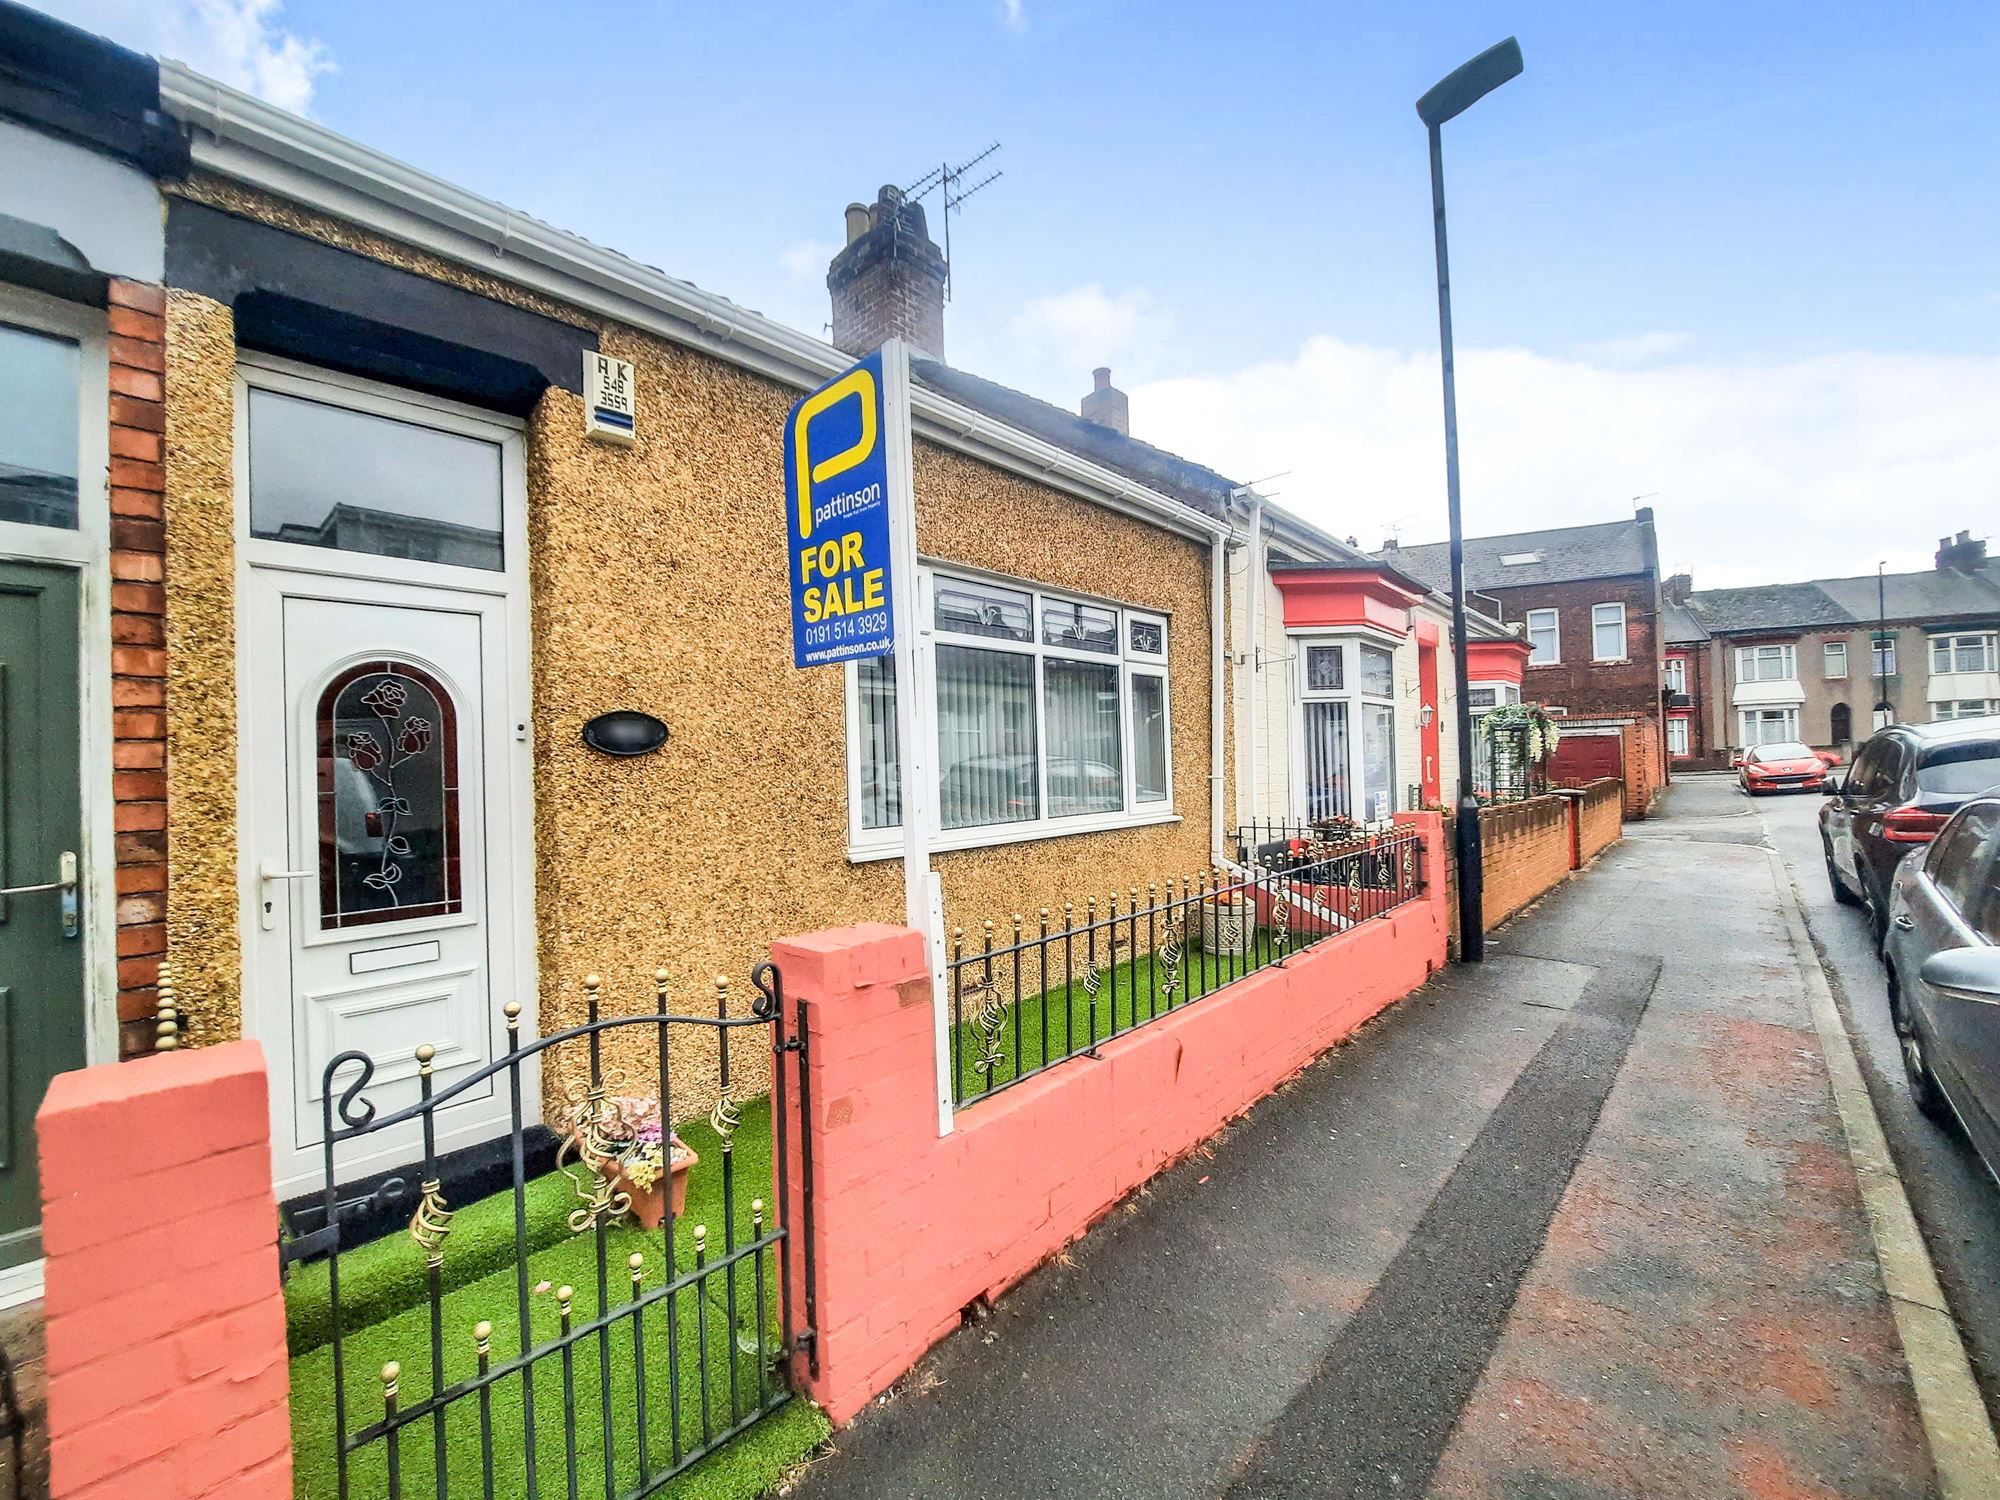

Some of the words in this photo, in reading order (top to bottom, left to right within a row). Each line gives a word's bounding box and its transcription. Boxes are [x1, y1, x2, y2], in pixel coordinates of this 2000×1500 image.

[600, 391, 627, 411] 3559
[603, 376, 623, 394] 548
[815, 483, 880, 528] pattinson
[801, 531, 865, 585] FOR
[803, 567, 885, 623] SALE
[806, 624, 830, 645] 0191
[834, 618, 855, 640] 514
[858, 611, 887, 635] 3929
[805, 636, 890, 661] www.pattinson.co.uk
